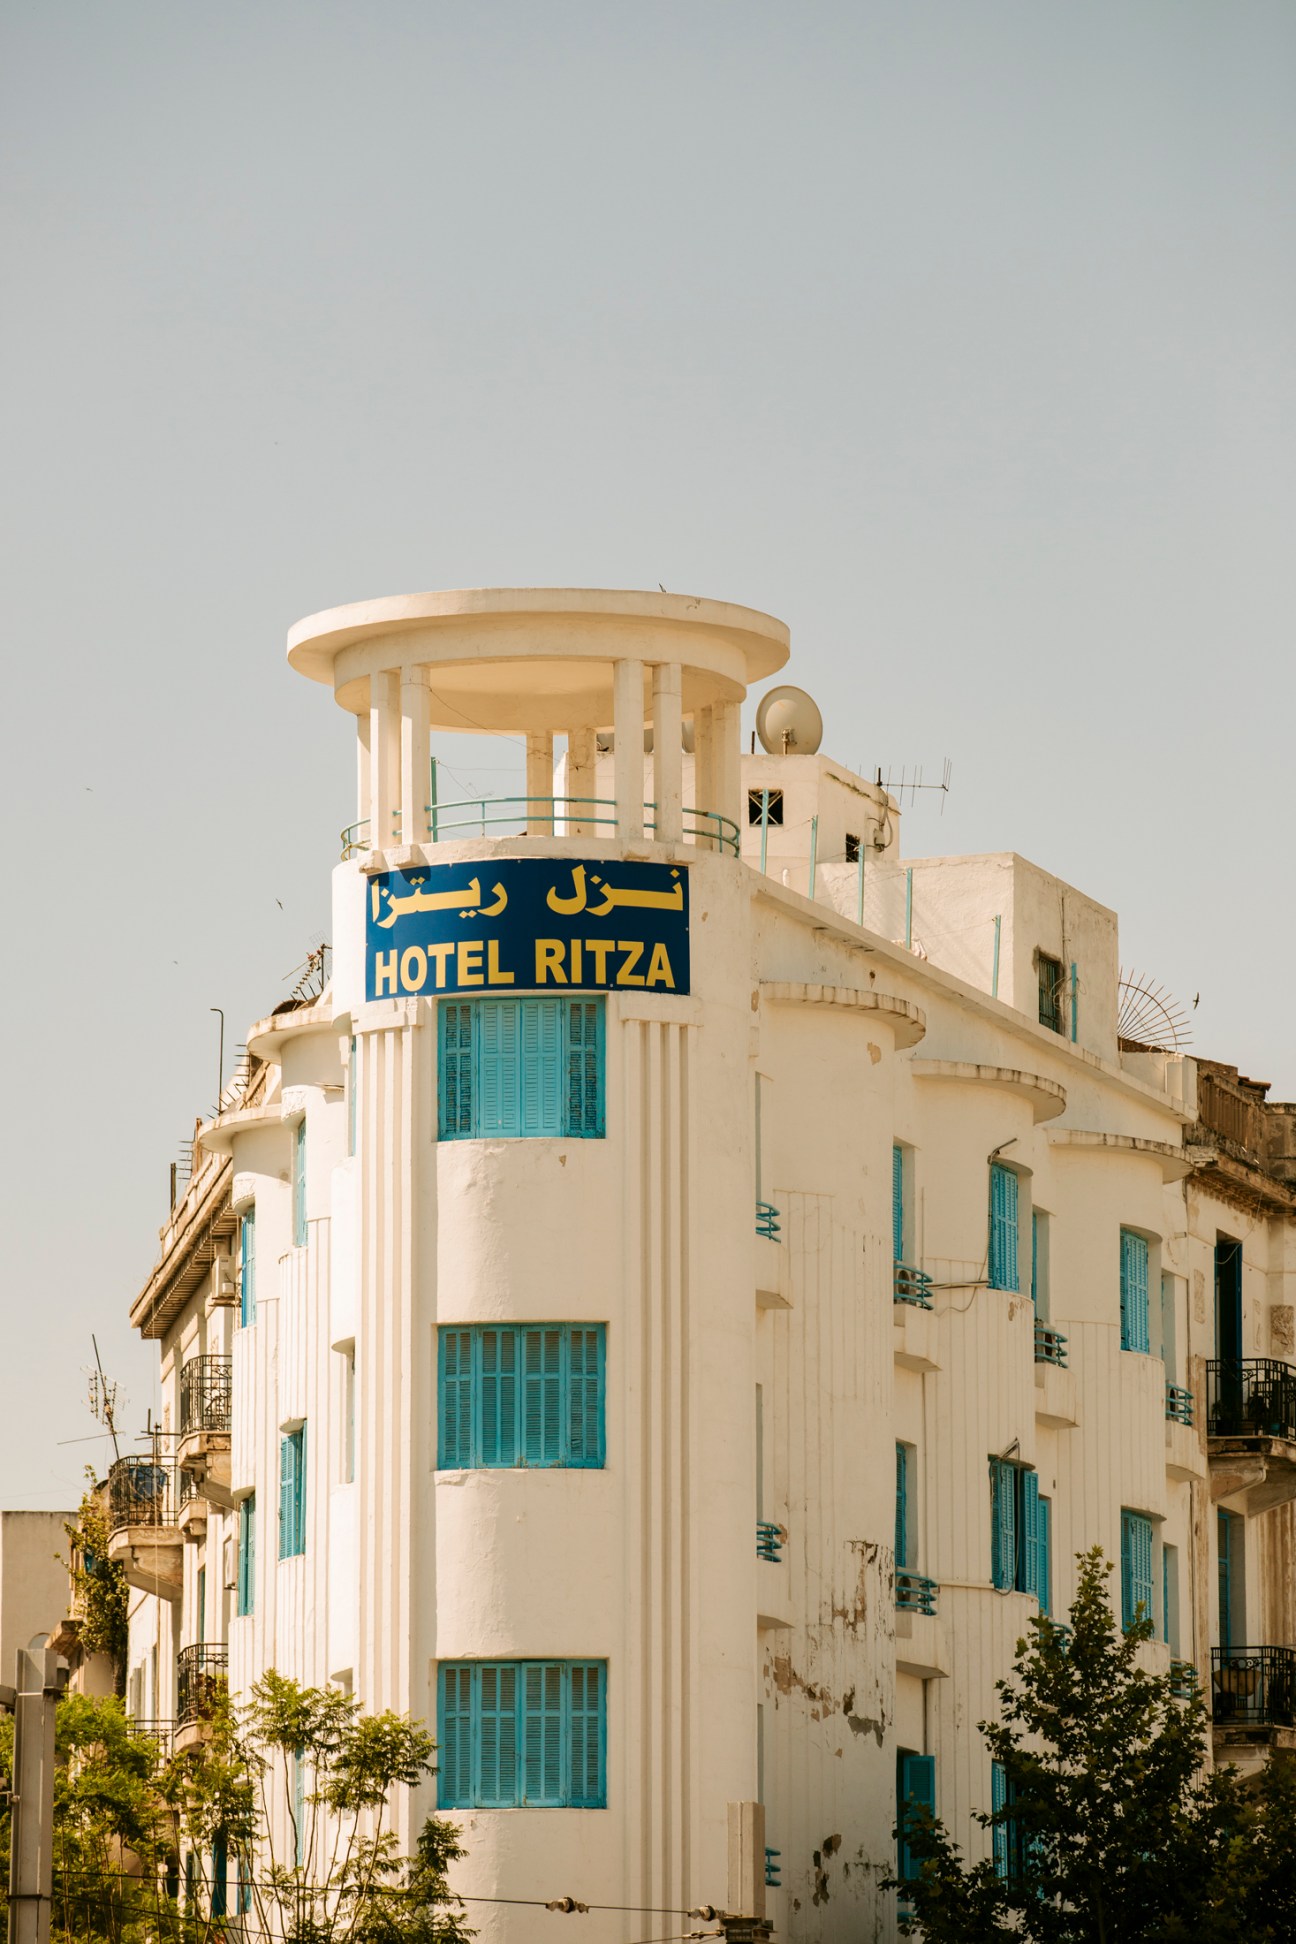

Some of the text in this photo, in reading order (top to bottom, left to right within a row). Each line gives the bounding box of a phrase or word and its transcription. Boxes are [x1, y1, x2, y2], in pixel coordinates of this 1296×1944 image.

[371, 864, 684, 929] نزل ريتزا
[375, 938, 676, 998] HOTEL RITZA
